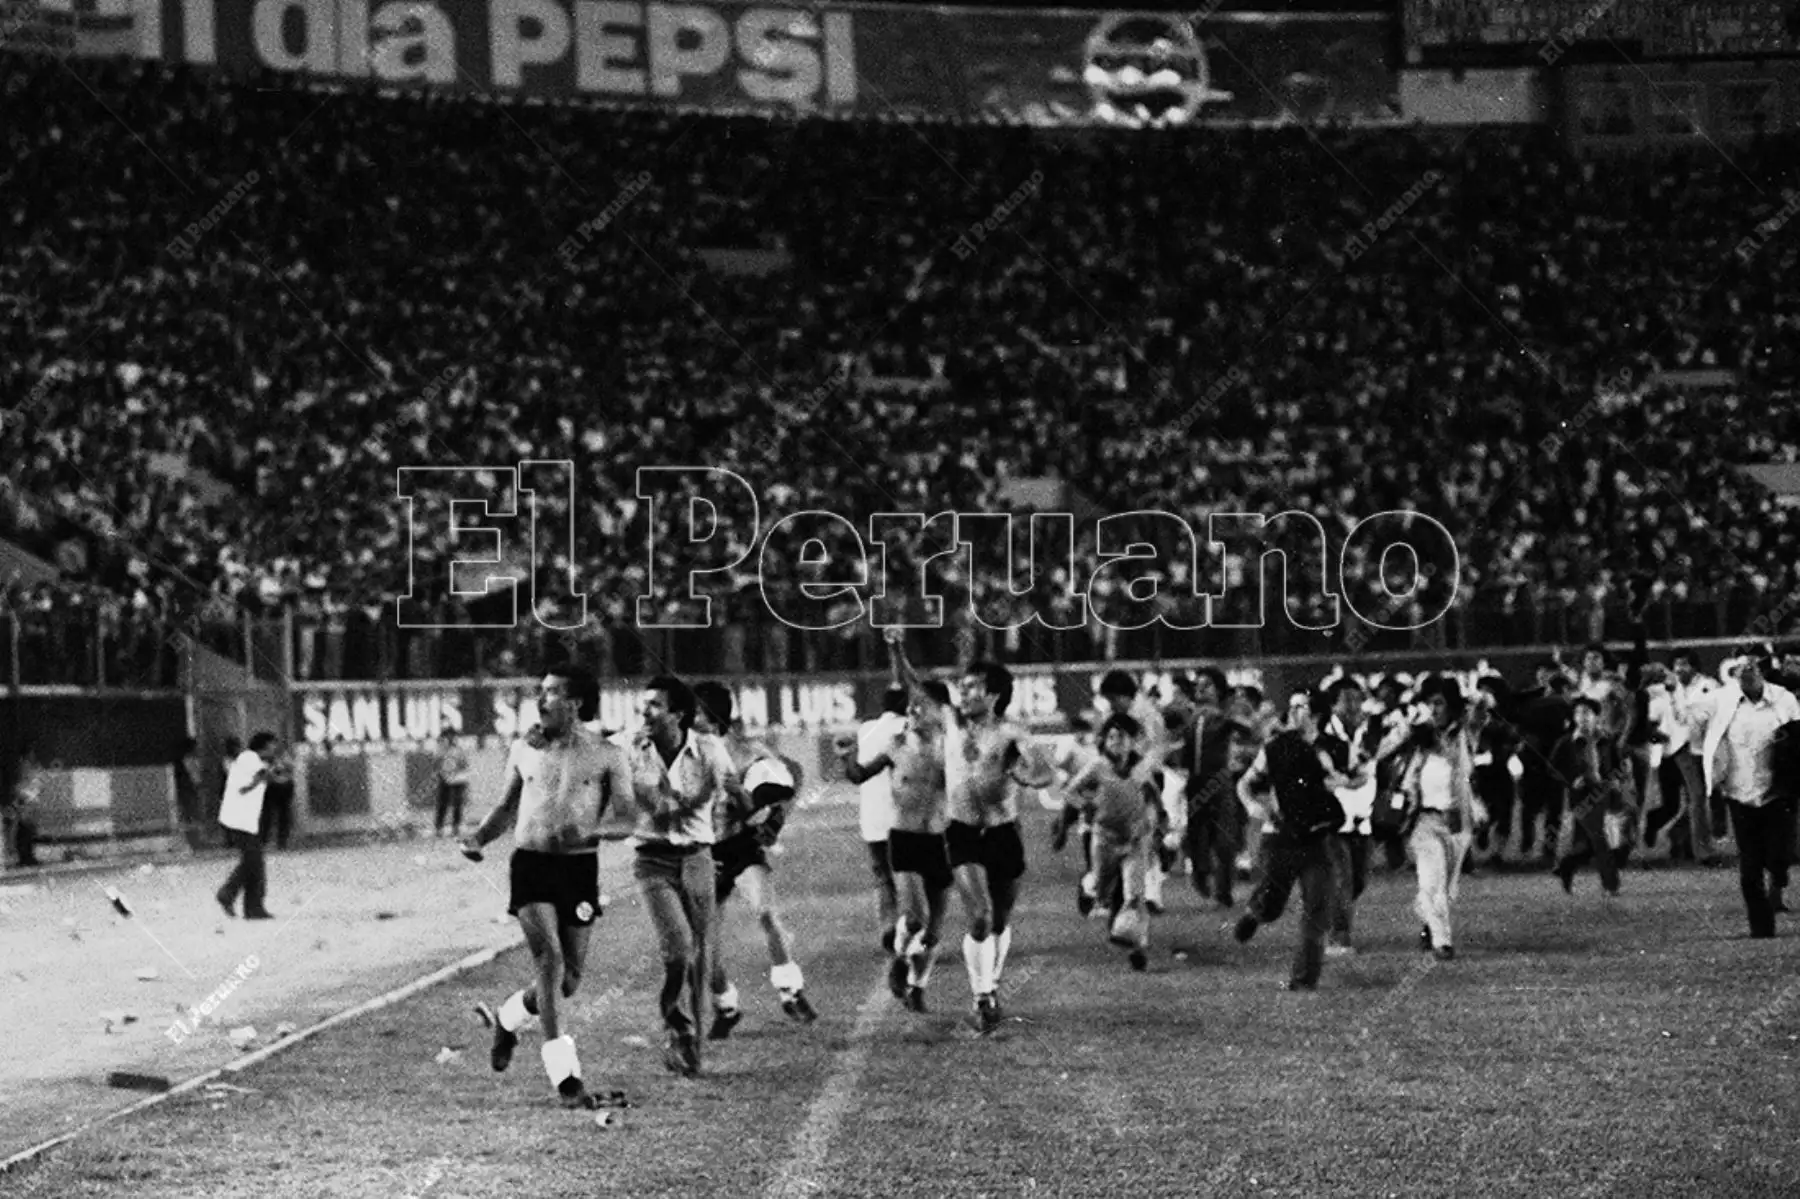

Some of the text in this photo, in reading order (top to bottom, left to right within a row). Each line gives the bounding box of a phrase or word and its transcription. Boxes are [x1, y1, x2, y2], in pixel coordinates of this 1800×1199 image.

[488, 0, 857, 102] PEPSI
[303, 693, 463, 743] SAN LUIS
[780, 682, 856, 726] LUIS
